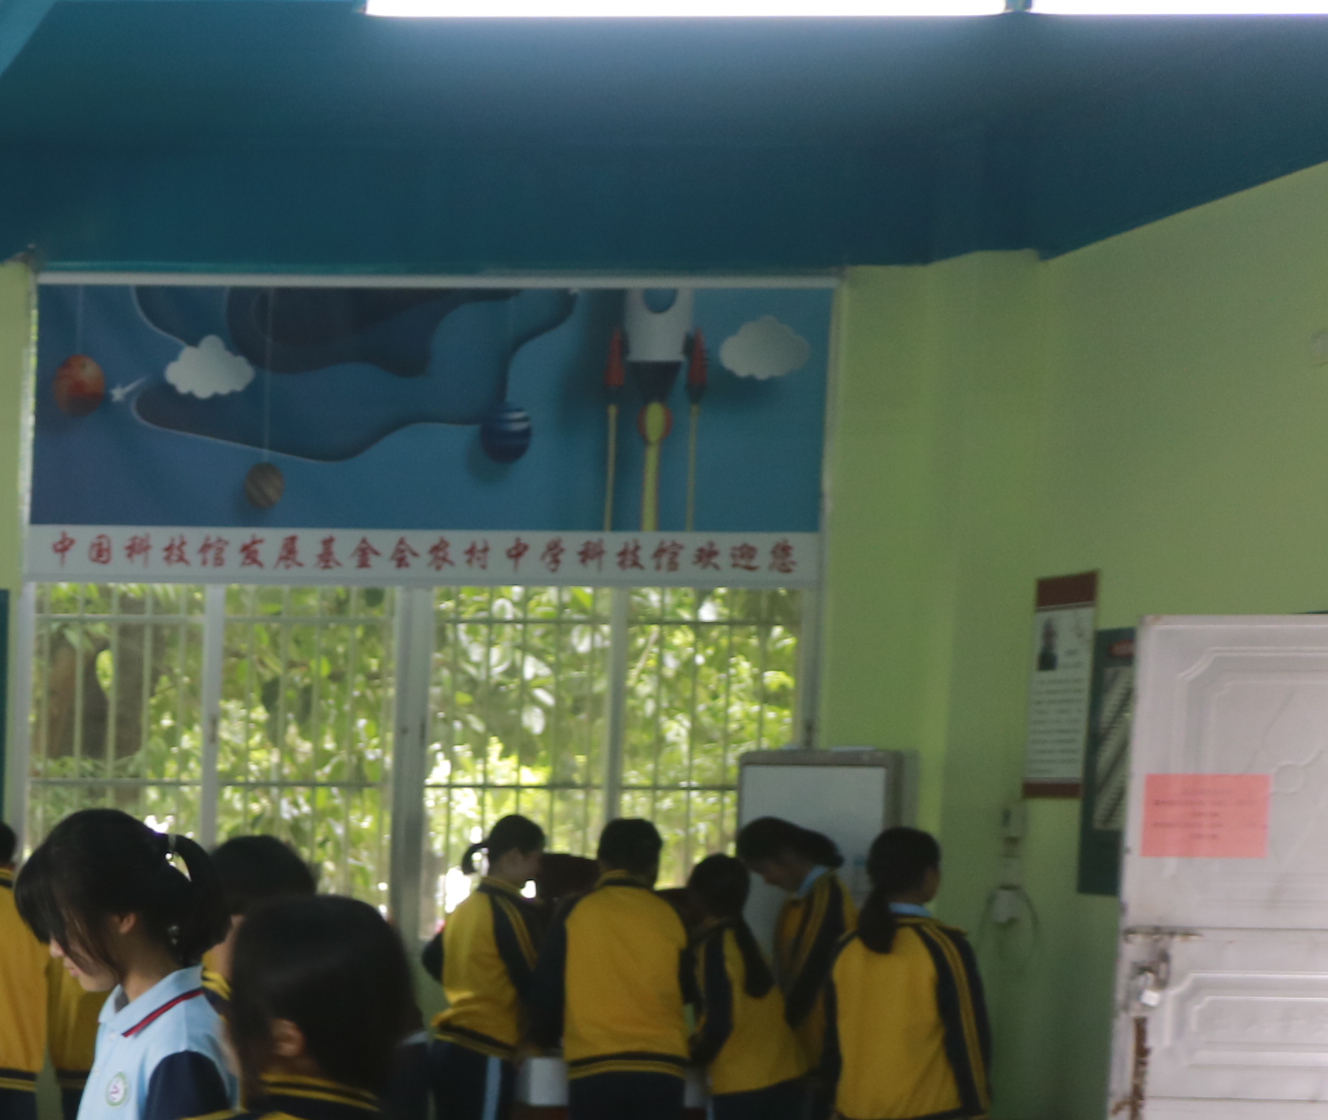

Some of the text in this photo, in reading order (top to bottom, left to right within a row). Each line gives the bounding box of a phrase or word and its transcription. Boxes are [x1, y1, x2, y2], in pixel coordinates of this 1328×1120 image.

[50, 530, 799, 575] 中国科技馆发展基金会农村中学科技馆欢迎您
